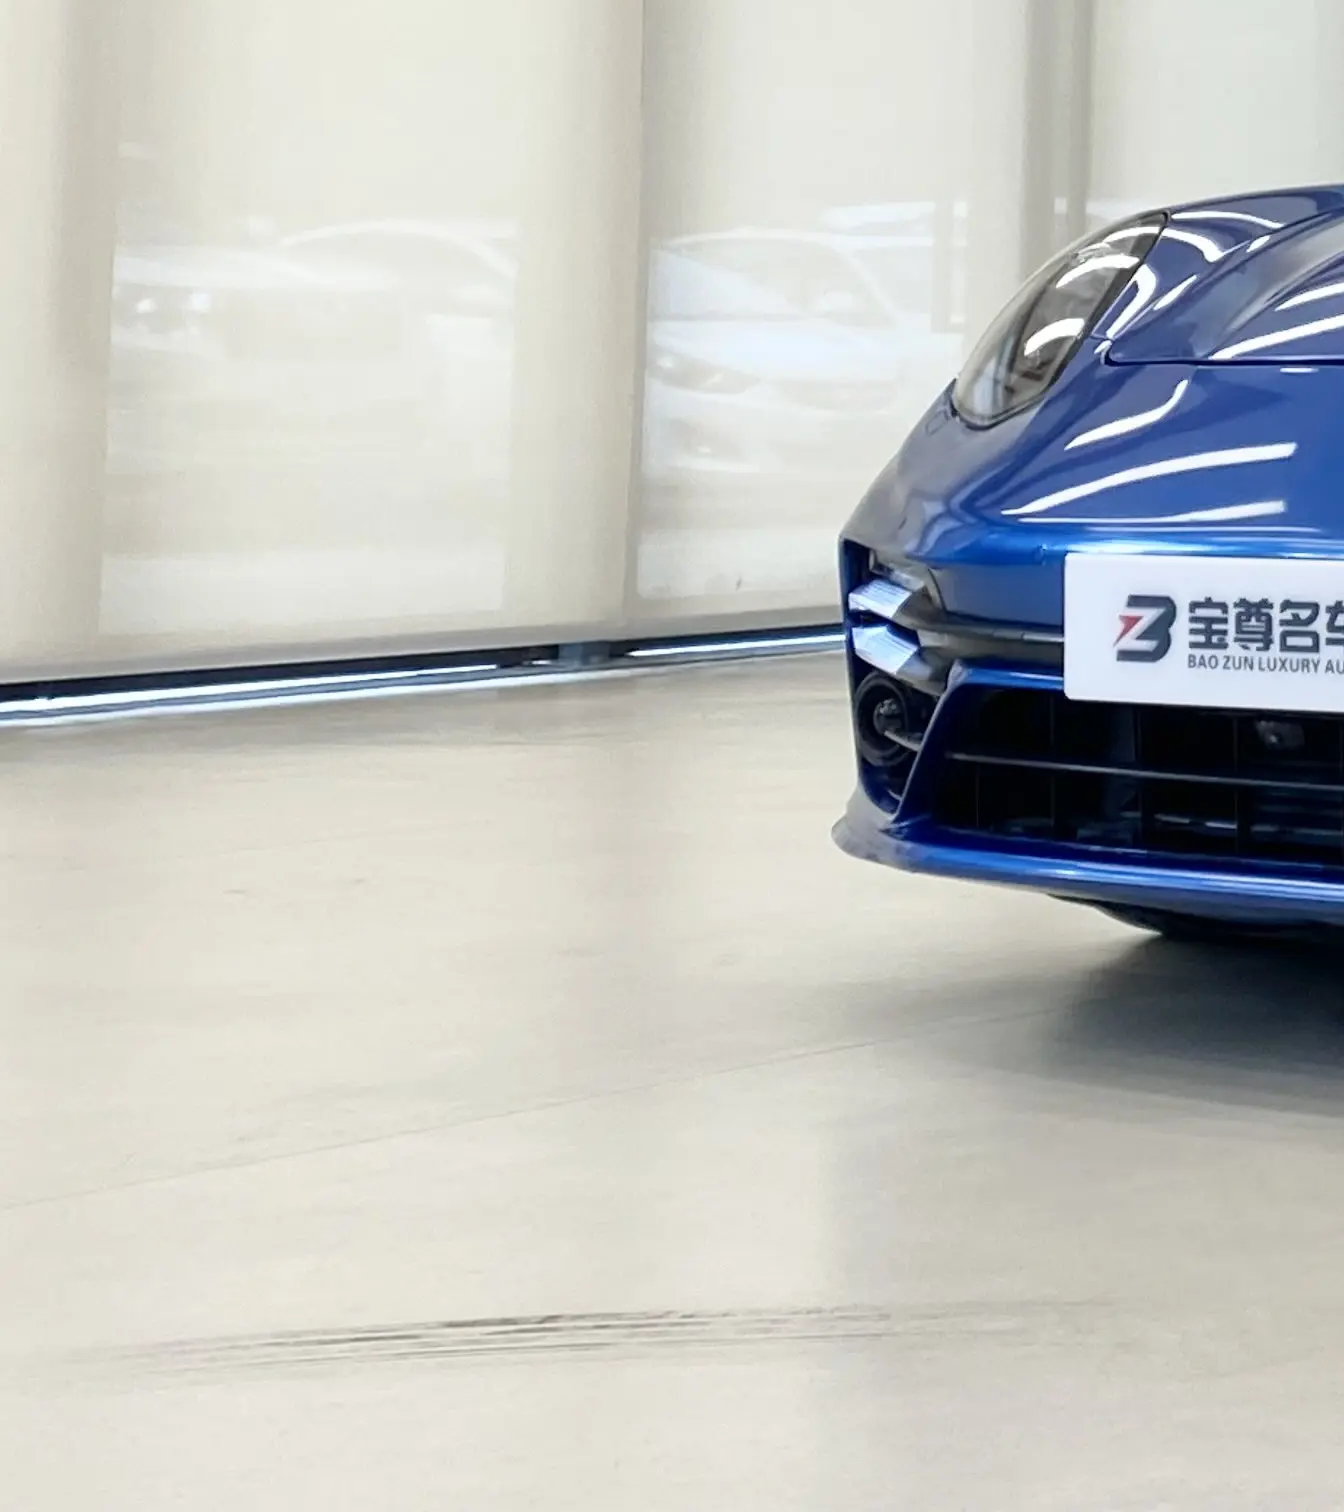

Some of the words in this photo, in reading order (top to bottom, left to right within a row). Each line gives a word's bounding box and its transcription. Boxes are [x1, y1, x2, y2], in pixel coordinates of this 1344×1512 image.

[1187, 653, 1219, 670] BAO
[1222, 655, 1254, 672] ZUN
[1258, 656, 1320, 675] LUXURY
